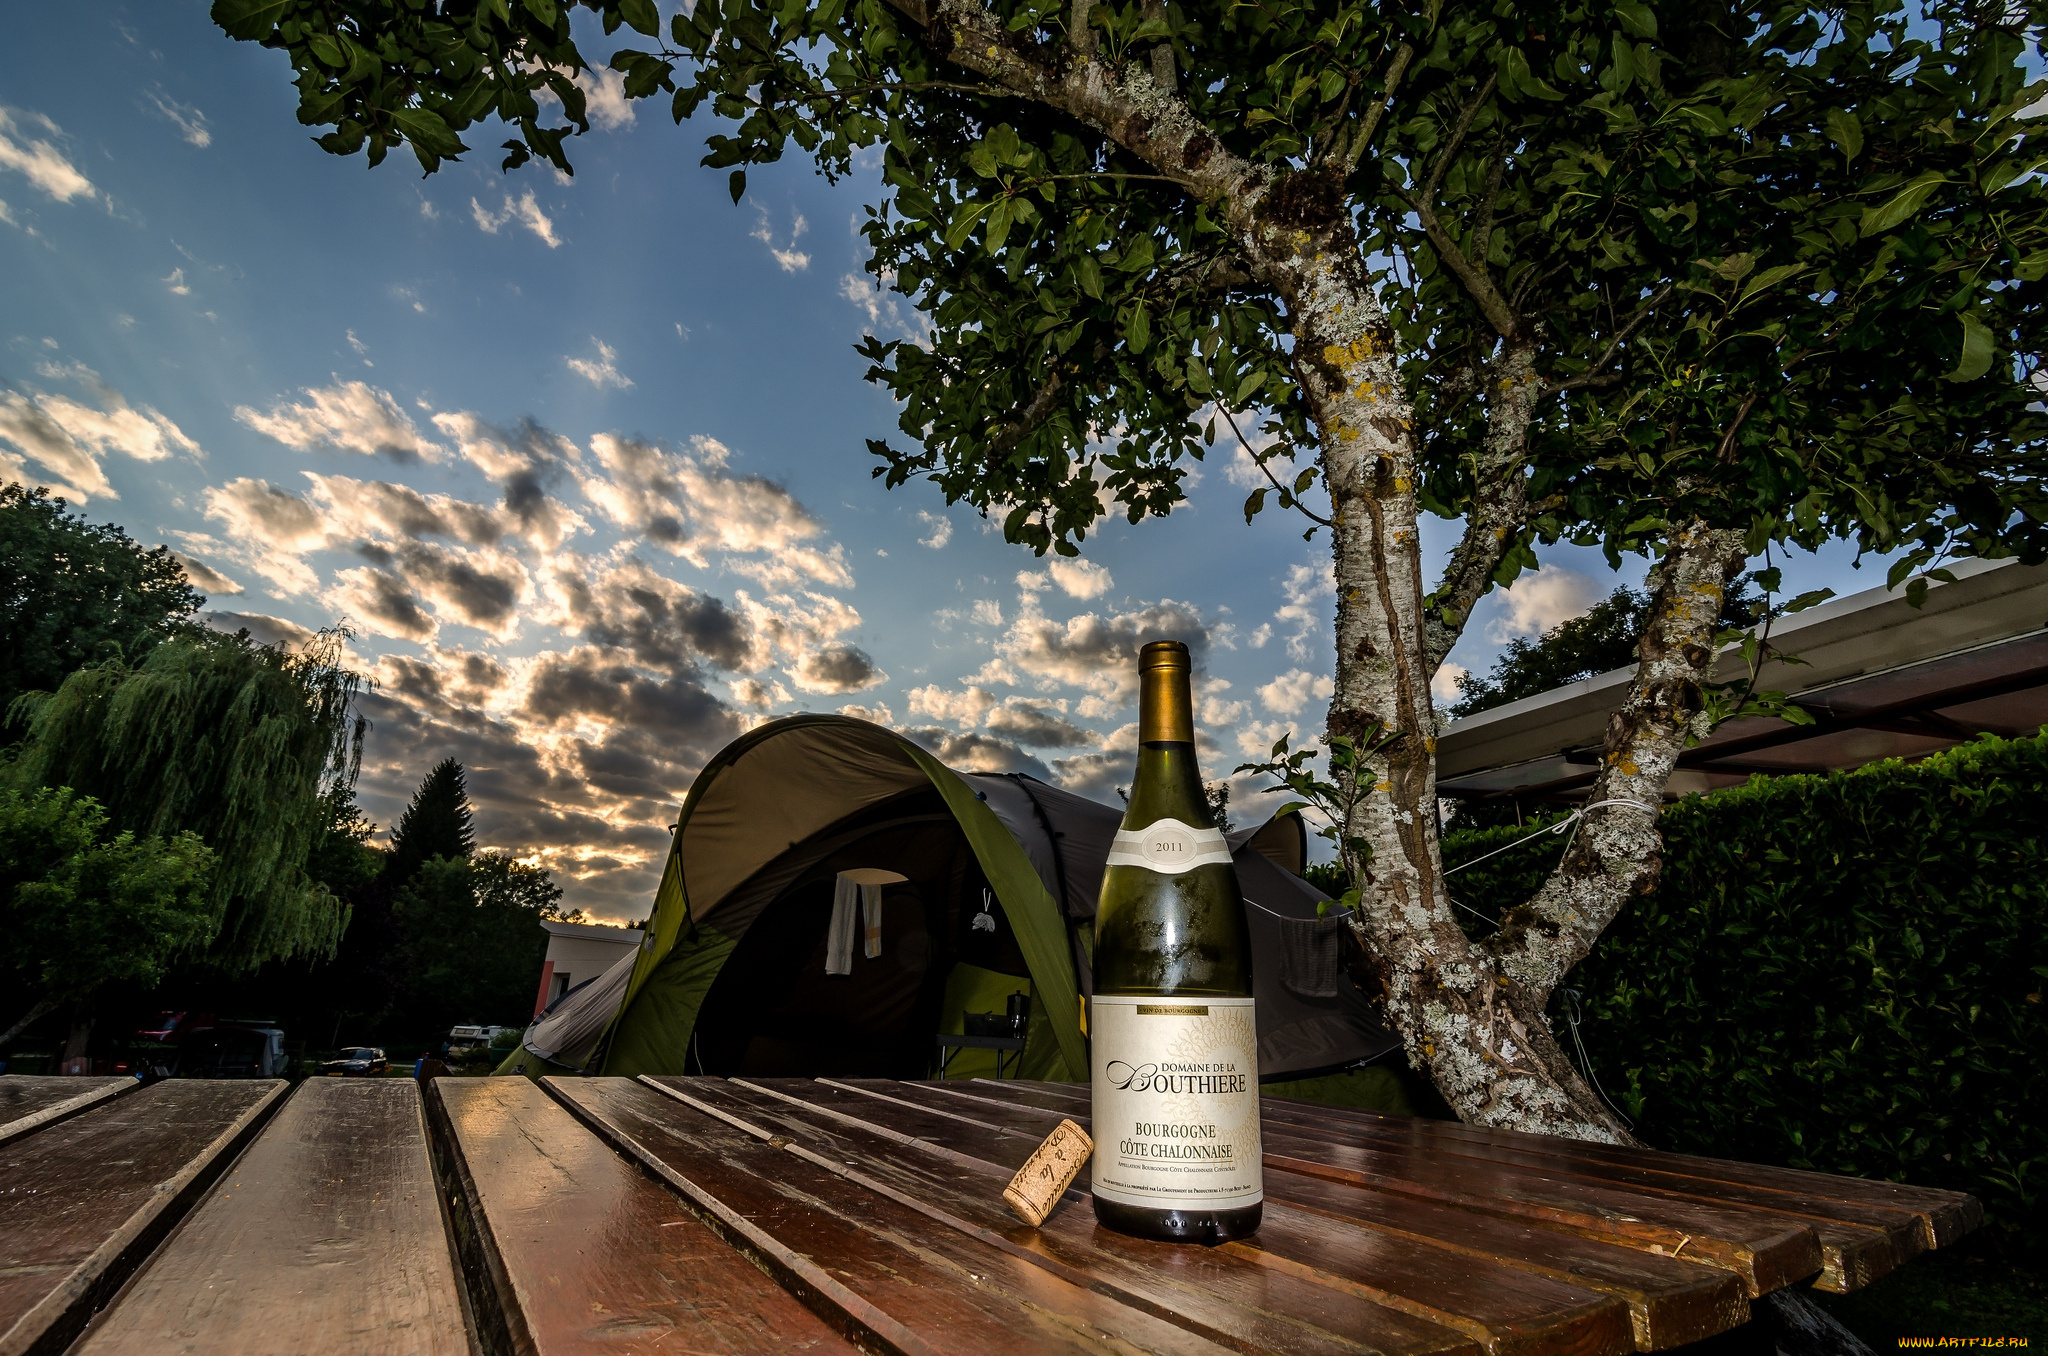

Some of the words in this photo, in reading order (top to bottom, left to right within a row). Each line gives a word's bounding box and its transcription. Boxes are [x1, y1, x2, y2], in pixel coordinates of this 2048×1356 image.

[1156, 842, 1182, 852] 2011
[1161, 1063, 1210, 1072] DOMAINE
[1213, 1063, 1224, 1072] DE
[1226, 1063, 1236, 1072] LA
[1106, 1060, 1246, 1094] BOUTHIERE
[1135, 1122, 1216, 1138] BOURGOGNE
[1055, 1149, 1066, 1161] à
[1120, 1138, 1148, 1156] CÔTE
[1151, 1144, 1232, 1159] CHALONNAISE
[1040, 1164, 1054, 1182] la
